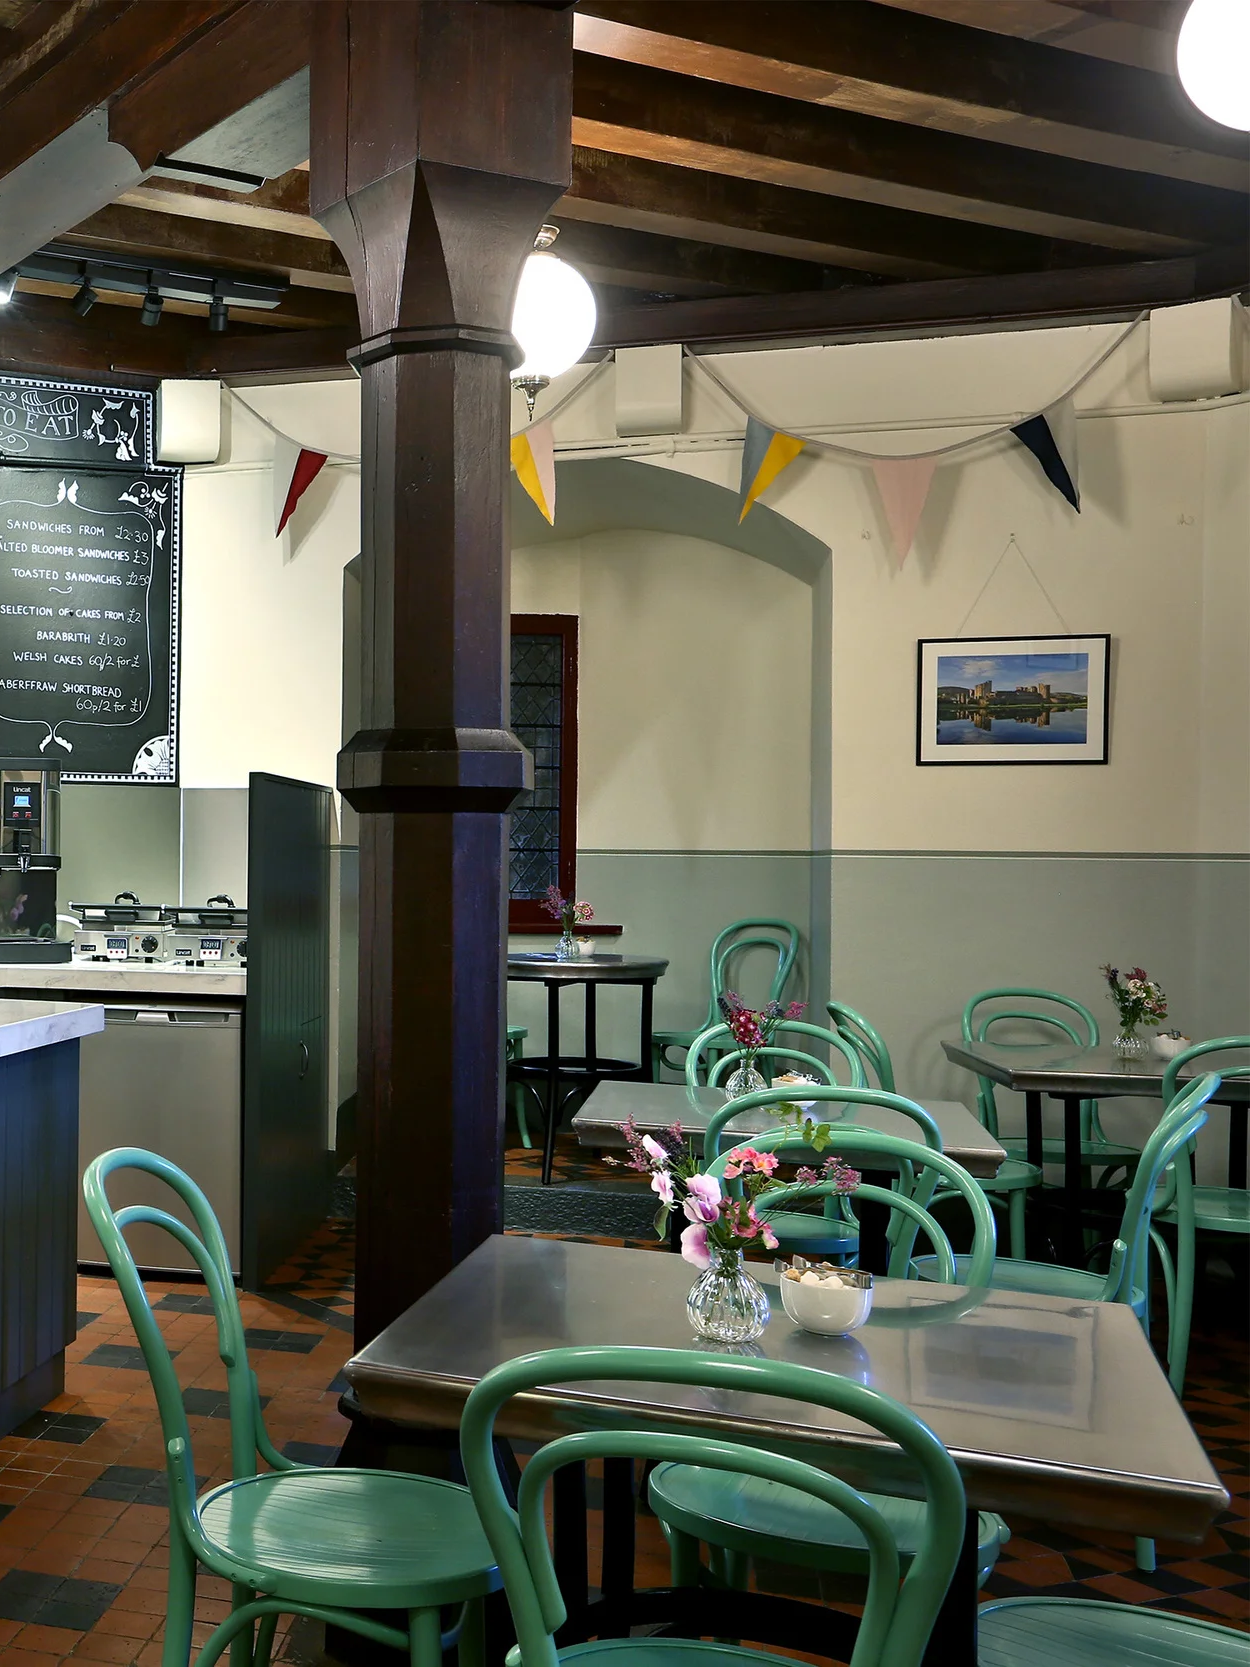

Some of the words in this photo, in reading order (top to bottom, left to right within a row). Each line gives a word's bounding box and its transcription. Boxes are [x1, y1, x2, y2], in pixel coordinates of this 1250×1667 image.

[24, 411, 74, 437] EAT
[6, 518, 73, 535] SANDWICHES
[78, 525, 105, 538] FROM
[31, 543, 75, 558] BLOOMER
[77, 547, 130, 562] SANDWICHES
[132, 549, 150, 566] £3
[11, 567, 59, 581] TOASTED
[64, 571, 123, 586] SANDWICHES
[0, 604, 53, 617] SELECTION
[58, 607, 71, 617] OF
[75, 608, 102, 619] CAKES
[104, 610, 125, 622] FROM
[126, 607, 142, 624] £2
[36, 630, 91, 644] BARABRITH
[12, 651, 48, 663] WELSH
[53, 654, 83, 666] CAKES
[116, 655, 132, 669] for
[61, 682, 122, 698] SHORTBREAD
[76, 697, 112, 714] 60p/2
[113, 701, 127, 713] for
[129, 697, 142, 713] £1
